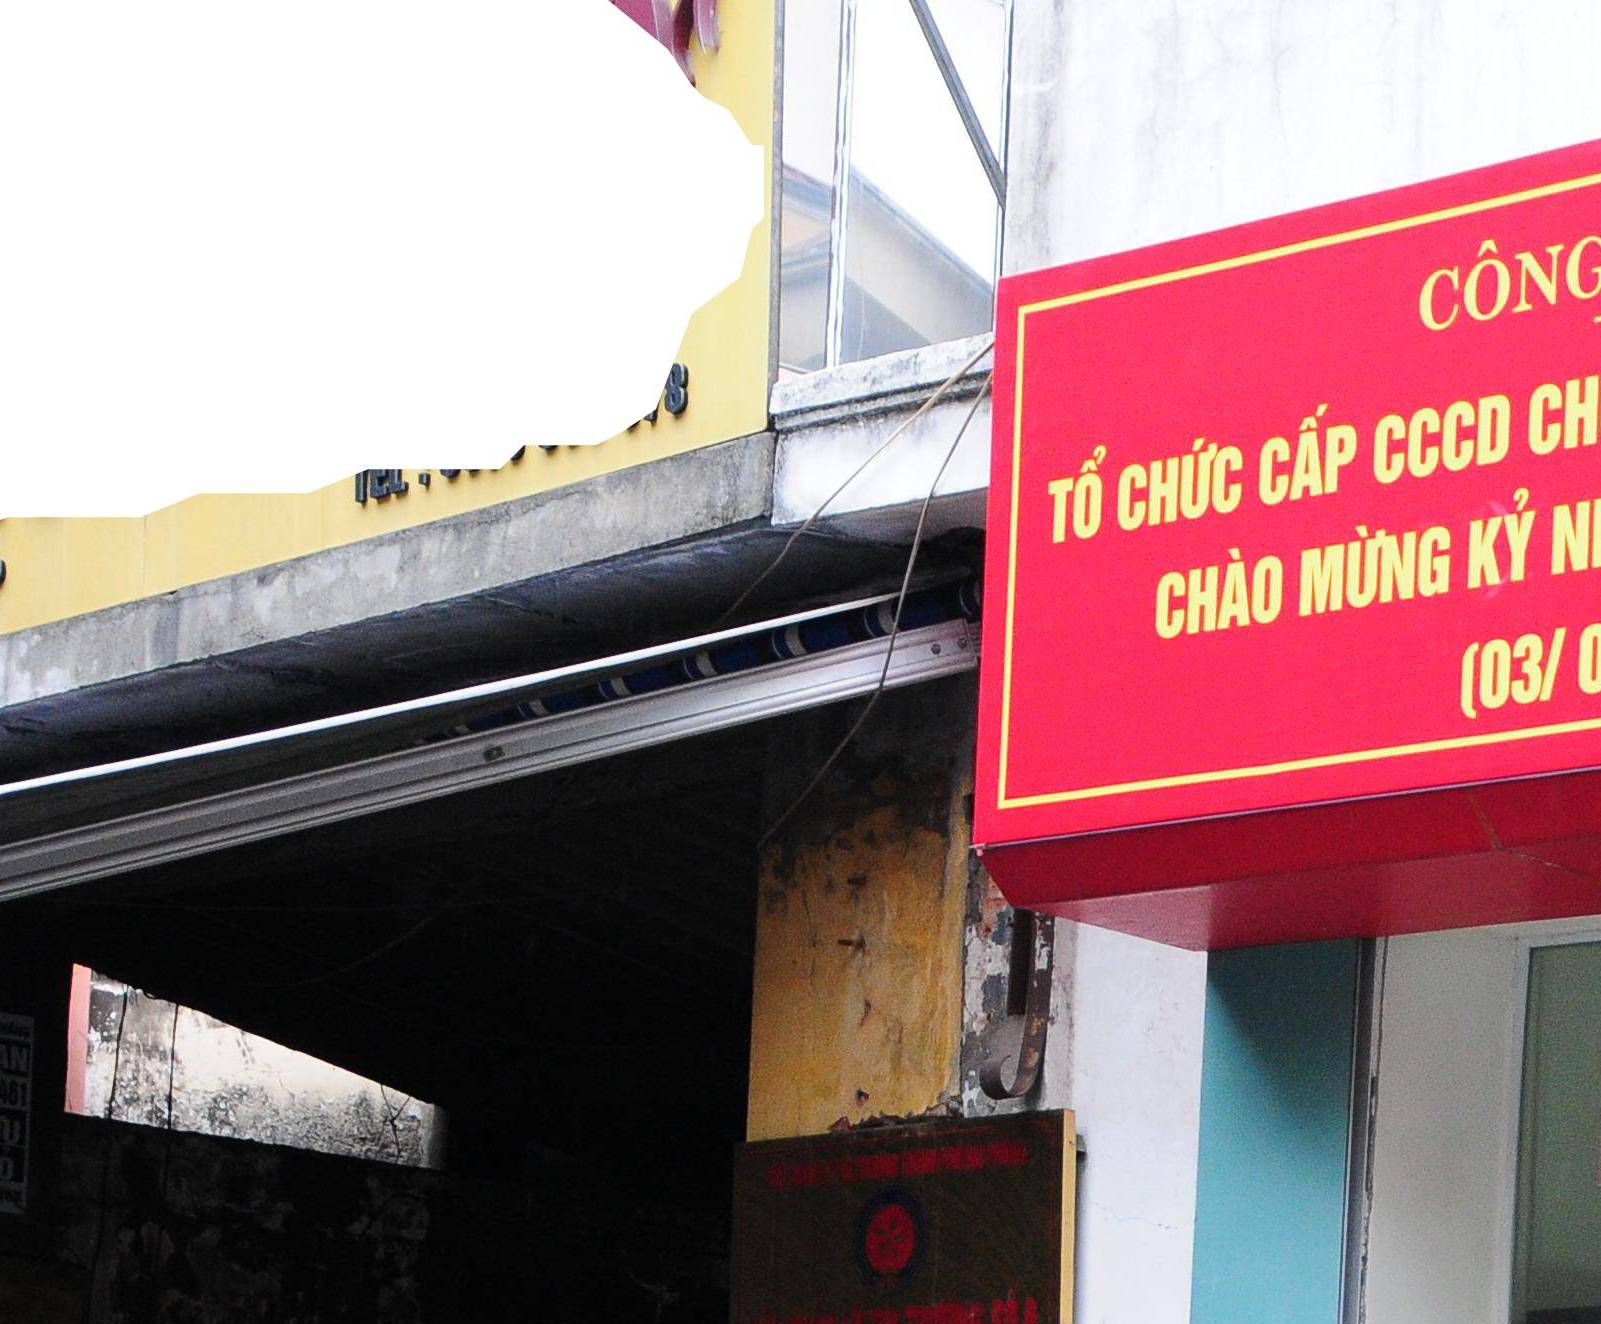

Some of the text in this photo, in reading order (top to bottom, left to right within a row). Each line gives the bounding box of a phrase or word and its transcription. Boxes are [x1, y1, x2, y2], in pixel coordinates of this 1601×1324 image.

[1047, 444, 1107, 544] TỔ
[1116, 437, 1244, 530] CHỨC
[1258, 403, 1358, 506] CẤP
[1373, 394, 1511, 485] CCCD
[1155, 547, 1284, 639] CHÀO
[1298, 524, 1451, 617] MỪNG
[1467, 487, 1537, 590] KỶ
[1460, 629, 1560, 719] (03/
